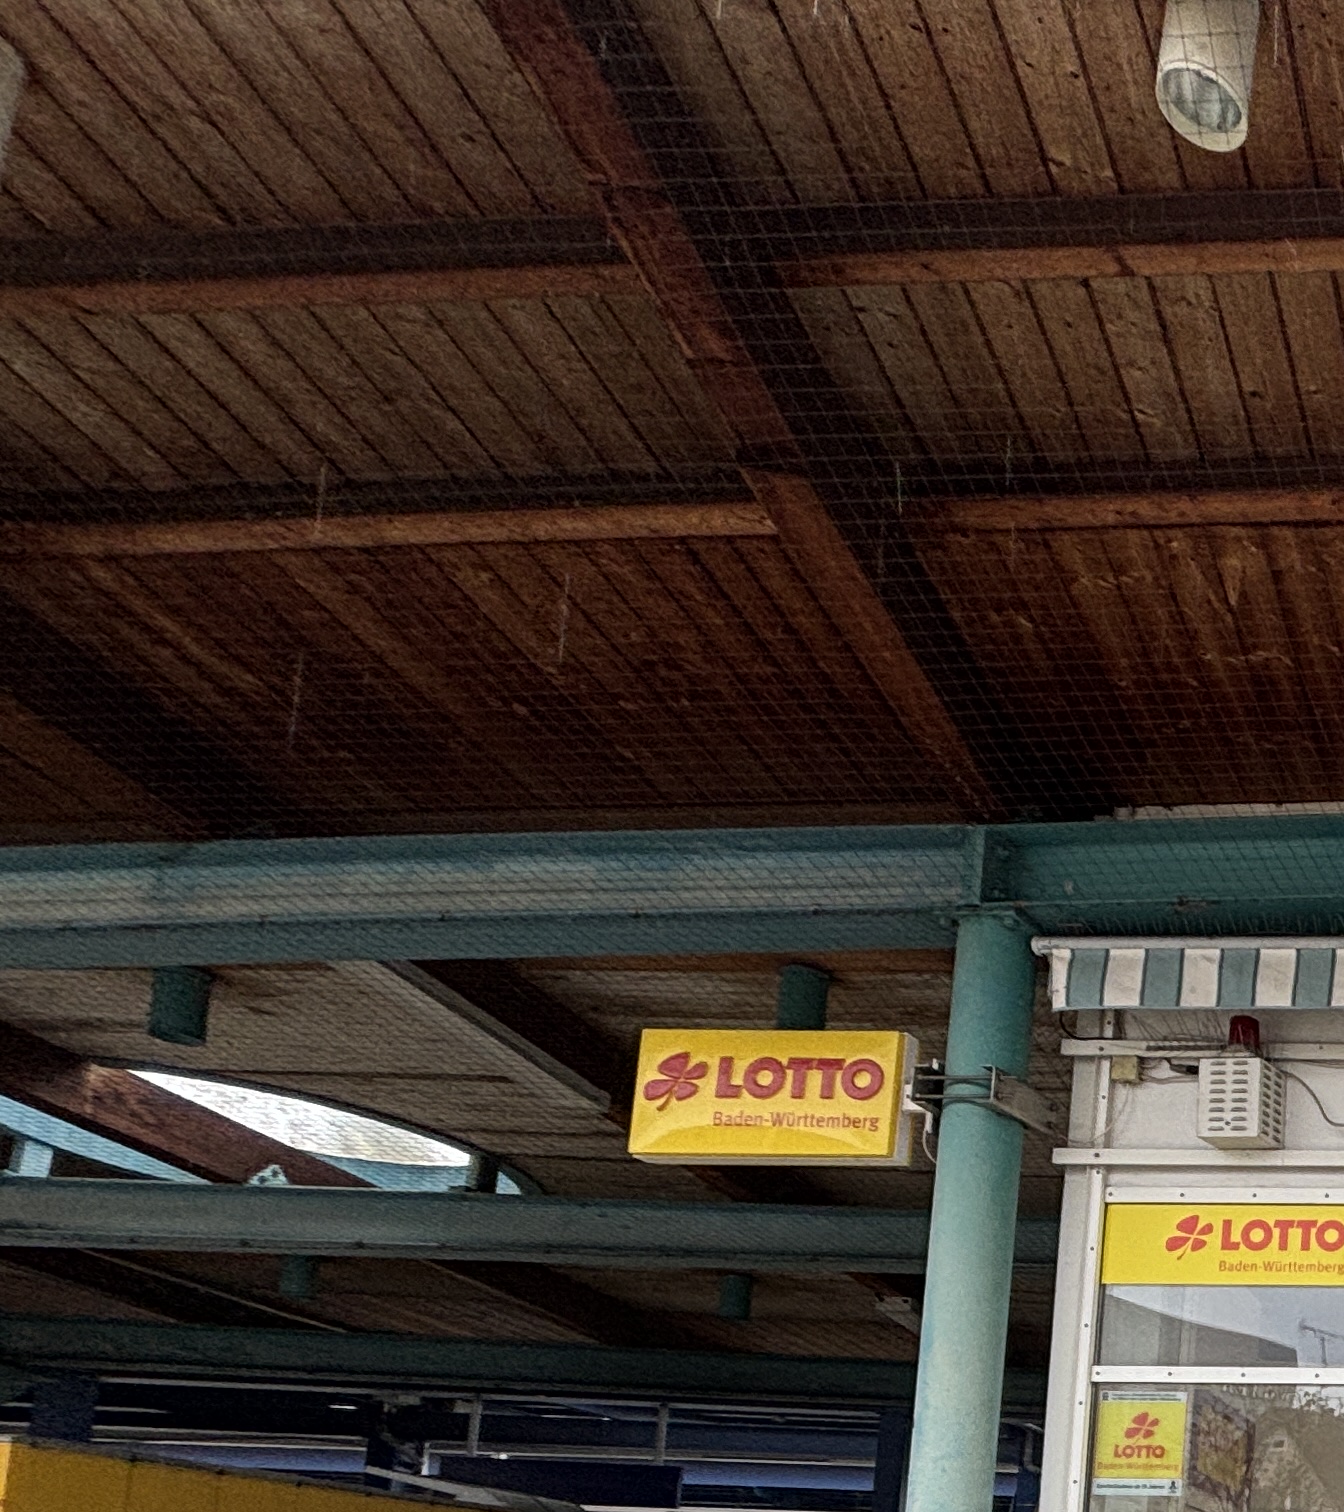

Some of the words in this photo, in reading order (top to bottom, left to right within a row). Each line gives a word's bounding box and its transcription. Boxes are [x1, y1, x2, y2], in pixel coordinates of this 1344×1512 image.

[715, 1056, 885, 1101] LOTTO
[712, 1111, 880, 1132] Baden-Württemberg
[1218, 1260, 1344, 1275] Baden-Württemberg
[1113, 1444, 1166, 1459] LOTTO
